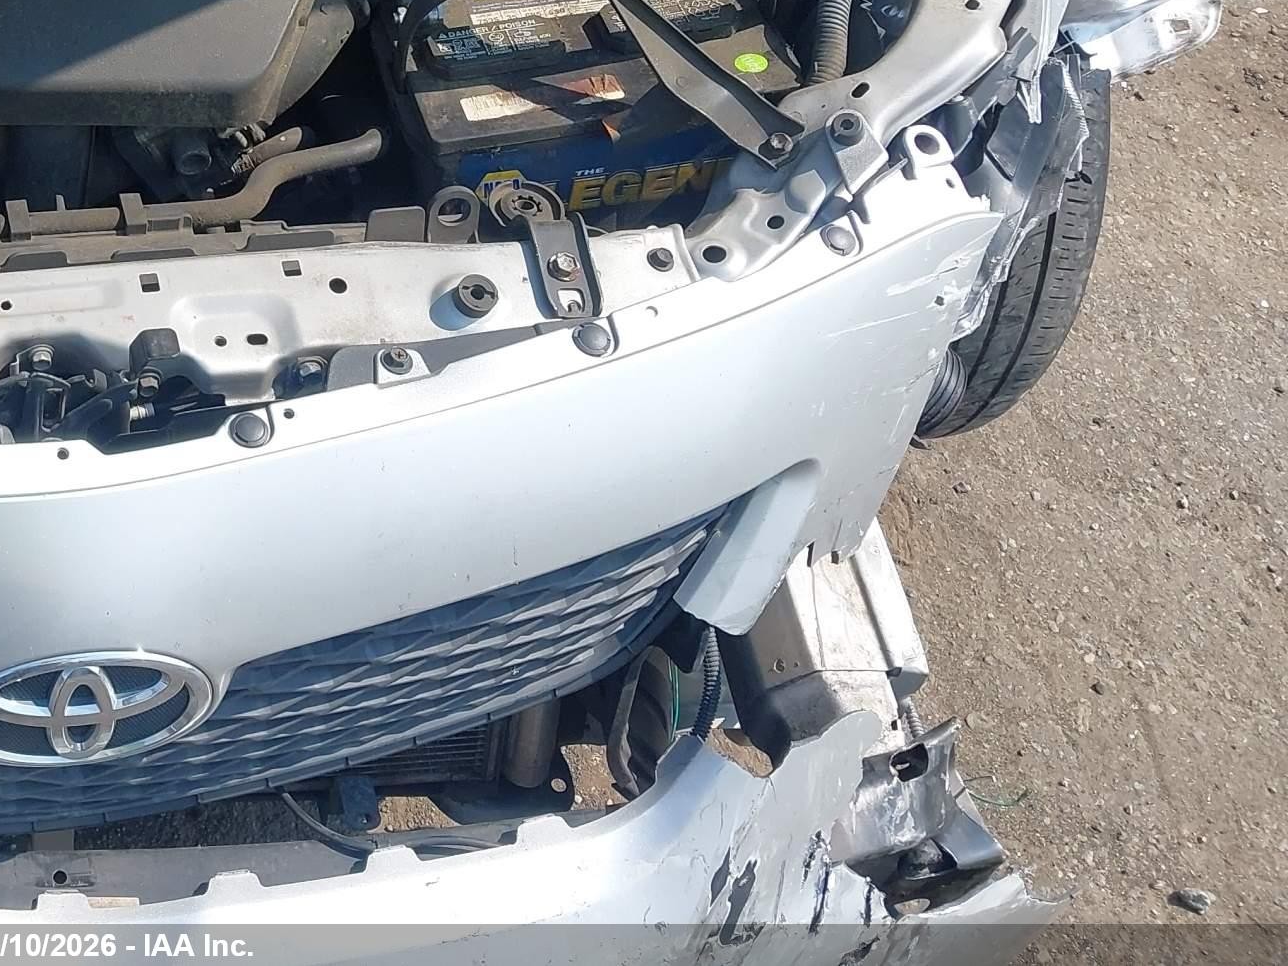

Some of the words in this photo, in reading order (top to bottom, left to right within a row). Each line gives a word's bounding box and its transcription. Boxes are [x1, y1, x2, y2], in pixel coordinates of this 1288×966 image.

[448, 26, 489, 38] DANGER
[499, 19, 536, 31] POISON
[575, 167, 606, 177] THE
